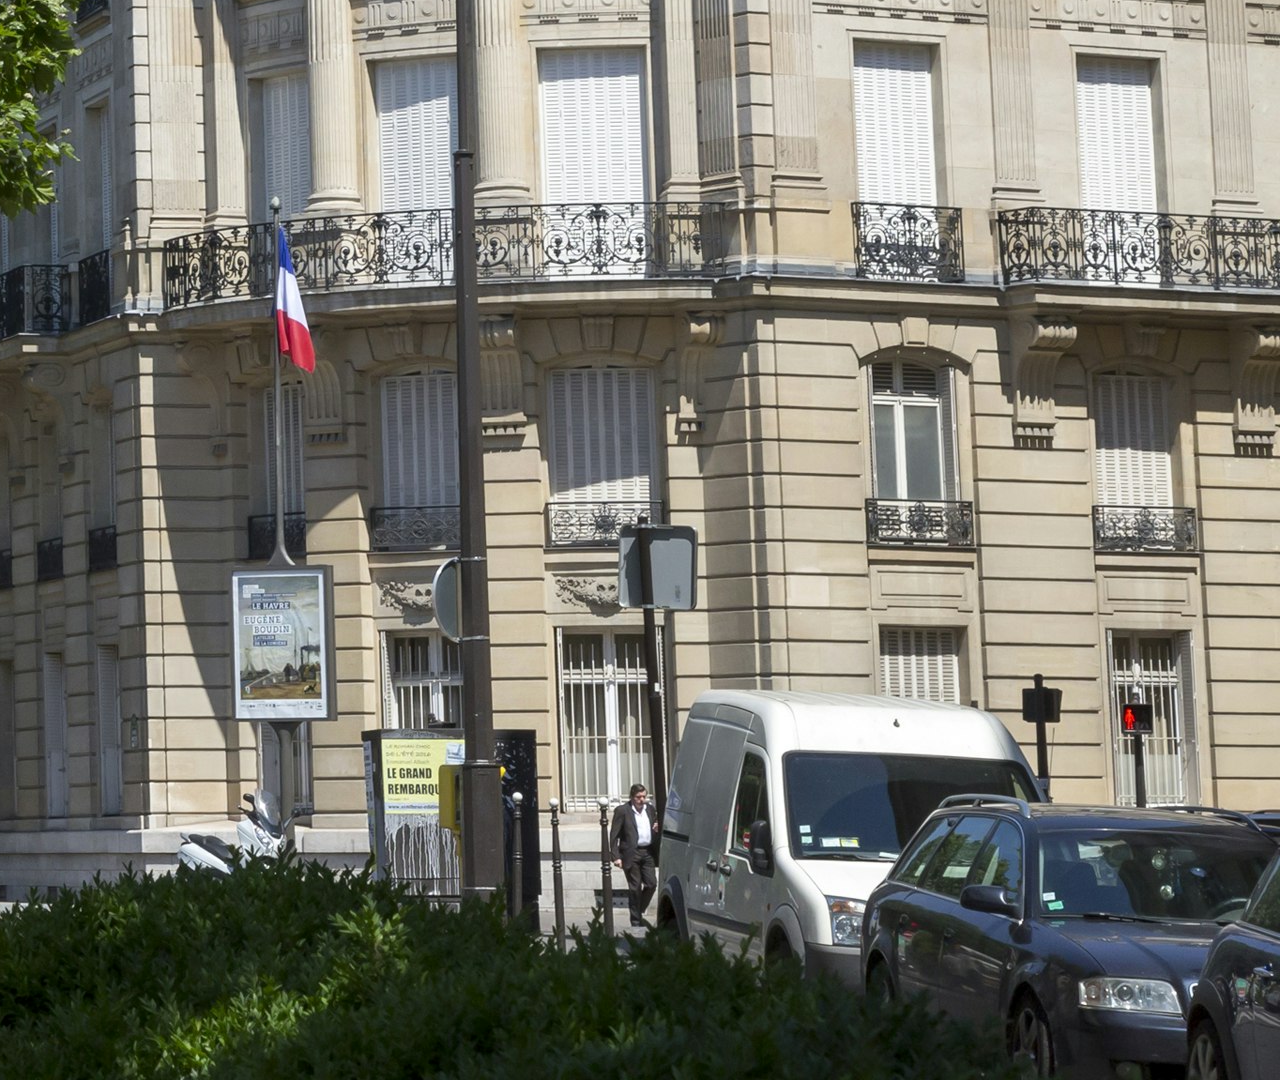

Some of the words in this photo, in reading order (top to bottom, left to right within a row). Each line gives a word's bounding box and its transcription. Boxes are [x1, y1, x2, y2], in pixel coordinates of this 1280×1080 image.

[252, 602, 262, 610] LE
[263, 602, 290, 610] HAVRE
[254, 625, 290, 634] BOUDIN
[387, 767, 397, 779] LE
[399, 767, 432, 779] GRAND
